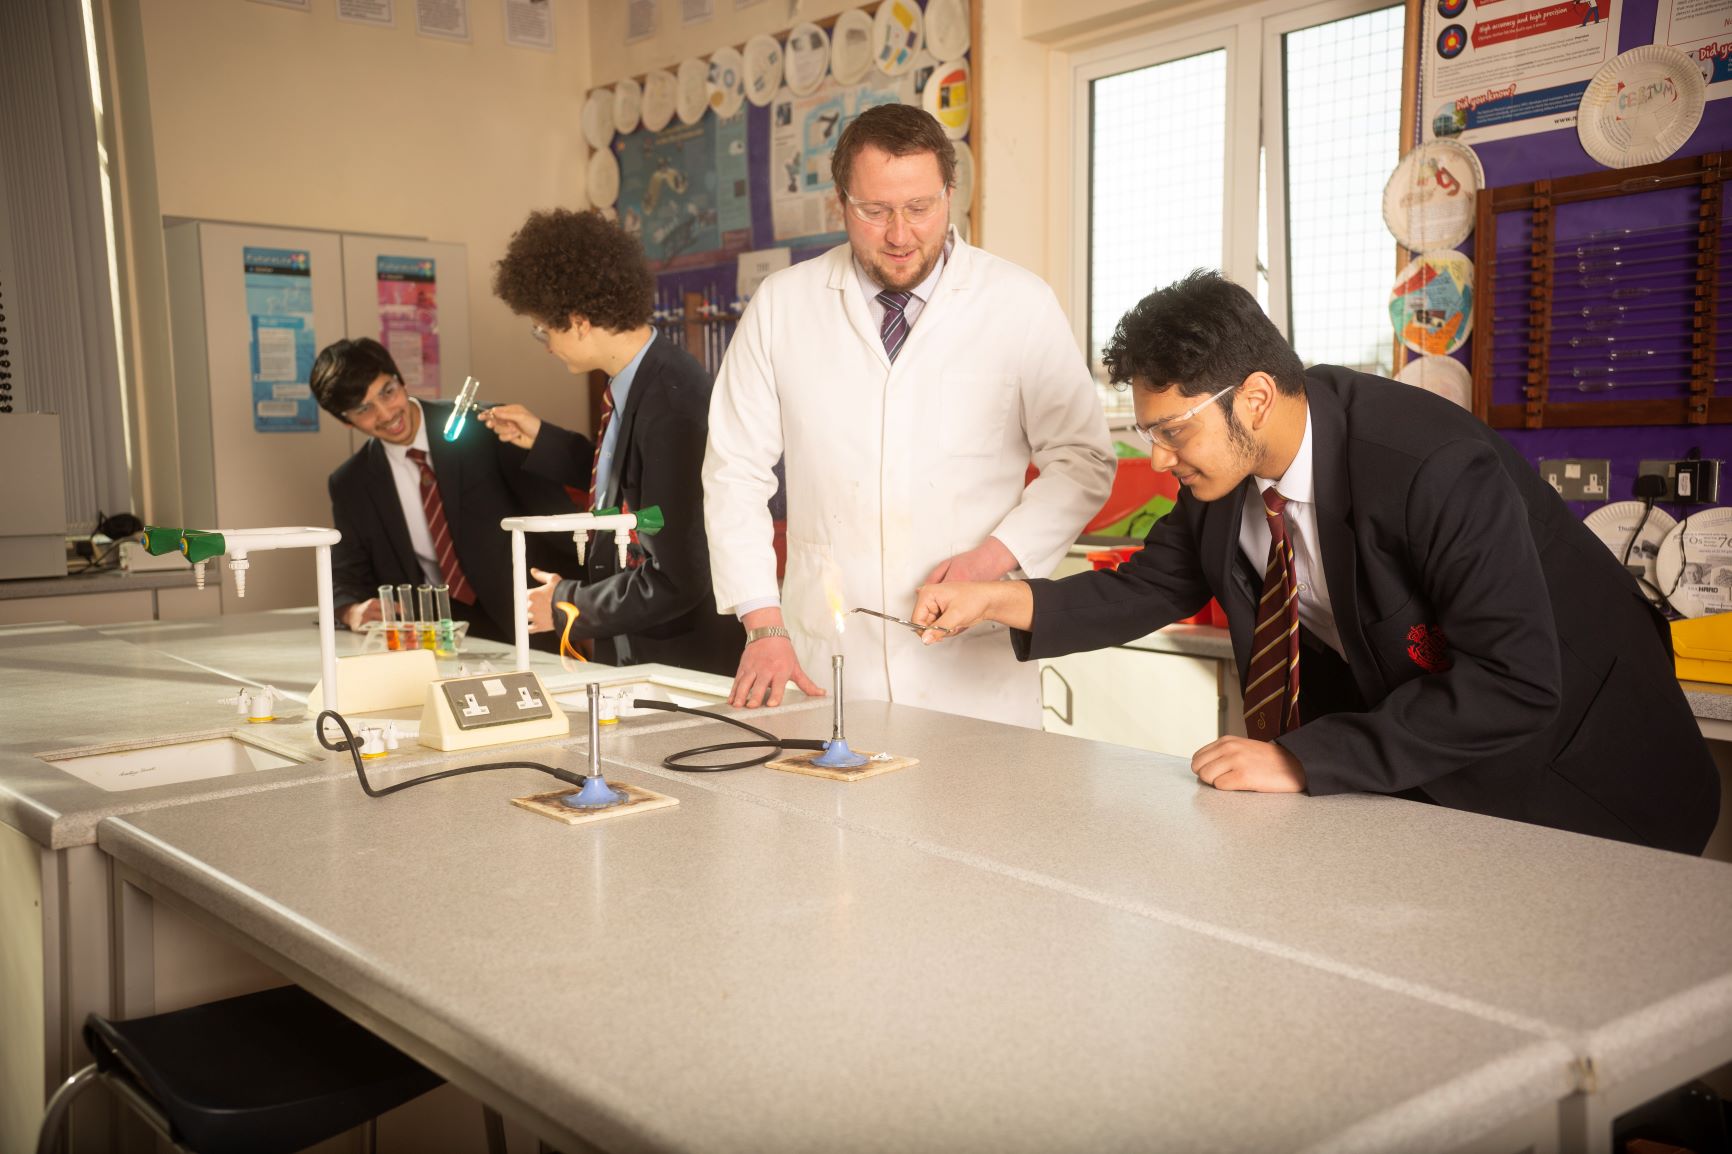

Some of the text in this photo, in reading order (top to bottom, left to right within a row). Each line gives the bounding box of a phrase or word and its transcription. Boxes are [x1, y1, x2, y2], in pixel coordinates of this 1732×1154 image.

[1492, 20, 1515, 30] accuracy
[1517, 16, 1528, 24] and
[1530, 13, 1541, 22] high
[1543, 8, 1568, 20] precision
[1699, 43, 1717, 60] Did
[1470, 95, 1486, 112] you
